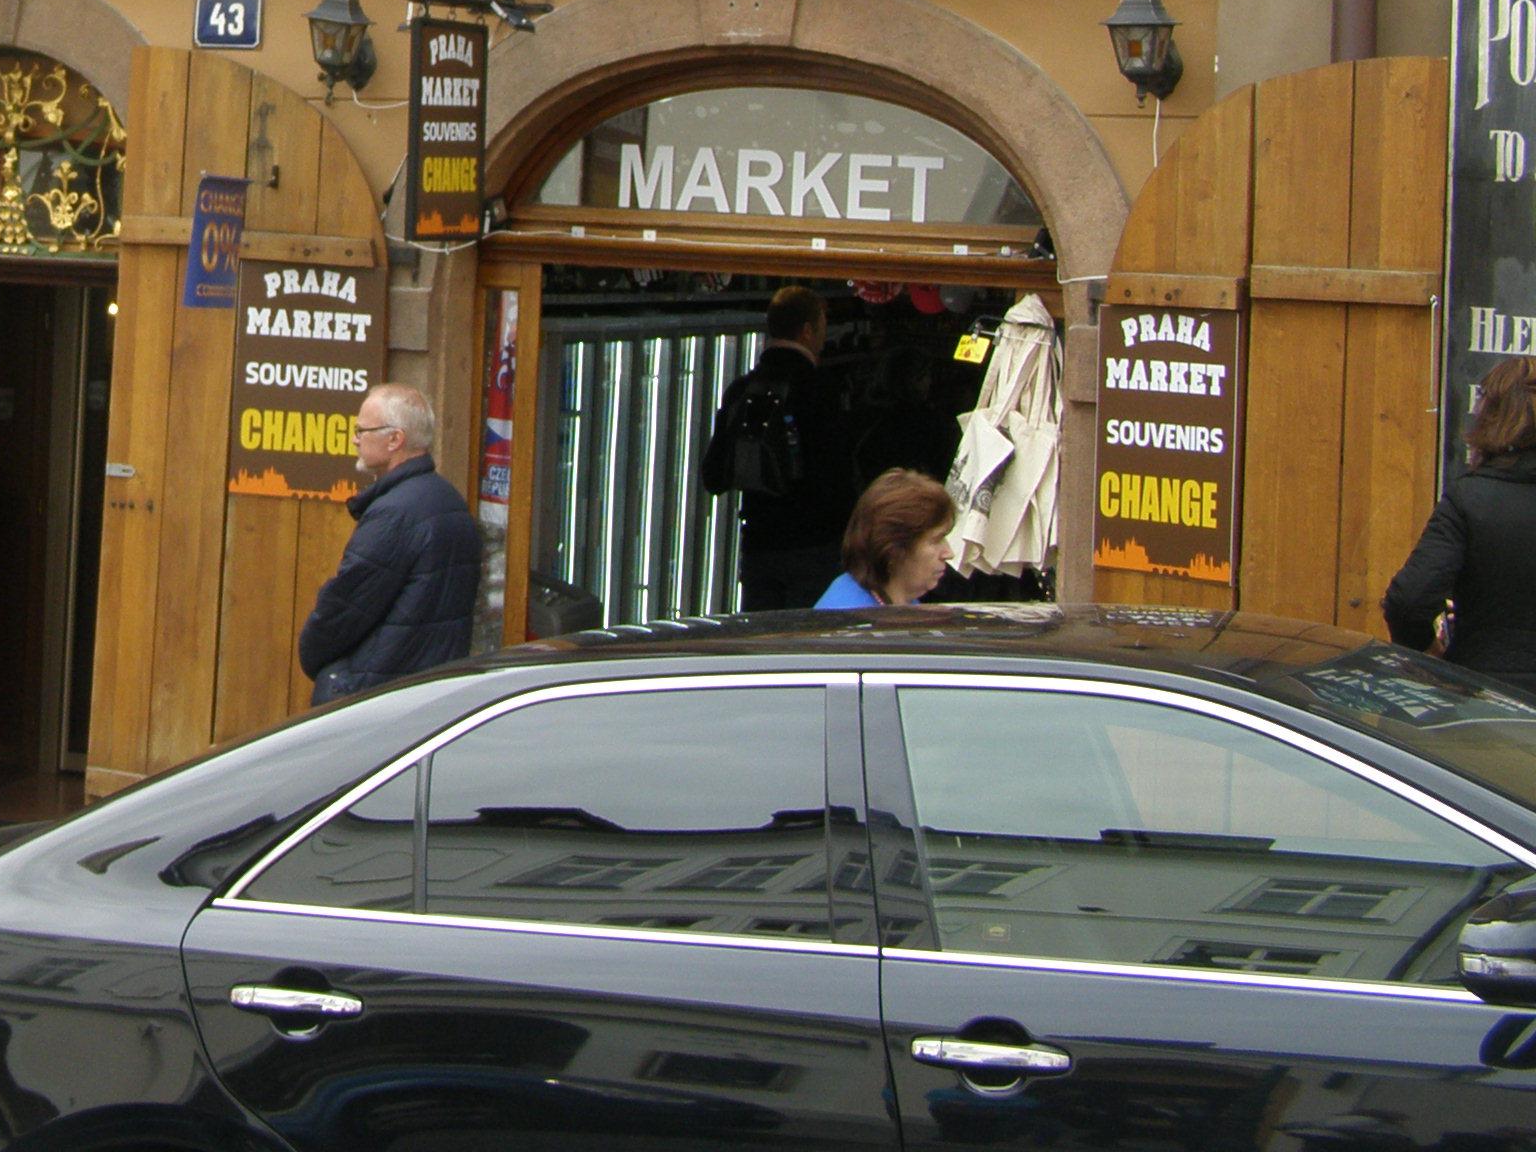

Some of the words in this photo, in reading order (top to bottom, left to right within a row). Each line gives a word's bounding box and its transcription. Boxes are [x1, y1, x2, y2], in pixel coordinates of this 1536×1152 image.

[209, 2, 245, 36] 43
[429, 32, 474, 68] PRAHA
[421, 75, 480, 107] MARKET
[422, 120, 477, 143] SOUVENIRS
[422, 155, 478, 193] CHANGE
[617, 143, 945, 223] MARKET
[263, 268, 358, 304] PRAHA
[246, 306, 372, 343] MARKET
[1120, 313, 1212, 353] PRAHA
[245, 361, 369, 393] SOUVENIRS
[1105, 357, 1226, 397] MARKET
[1105, 418, 1225, 454] SOUVENIRS
[1099, 470, 1218, 530] CHANGE
